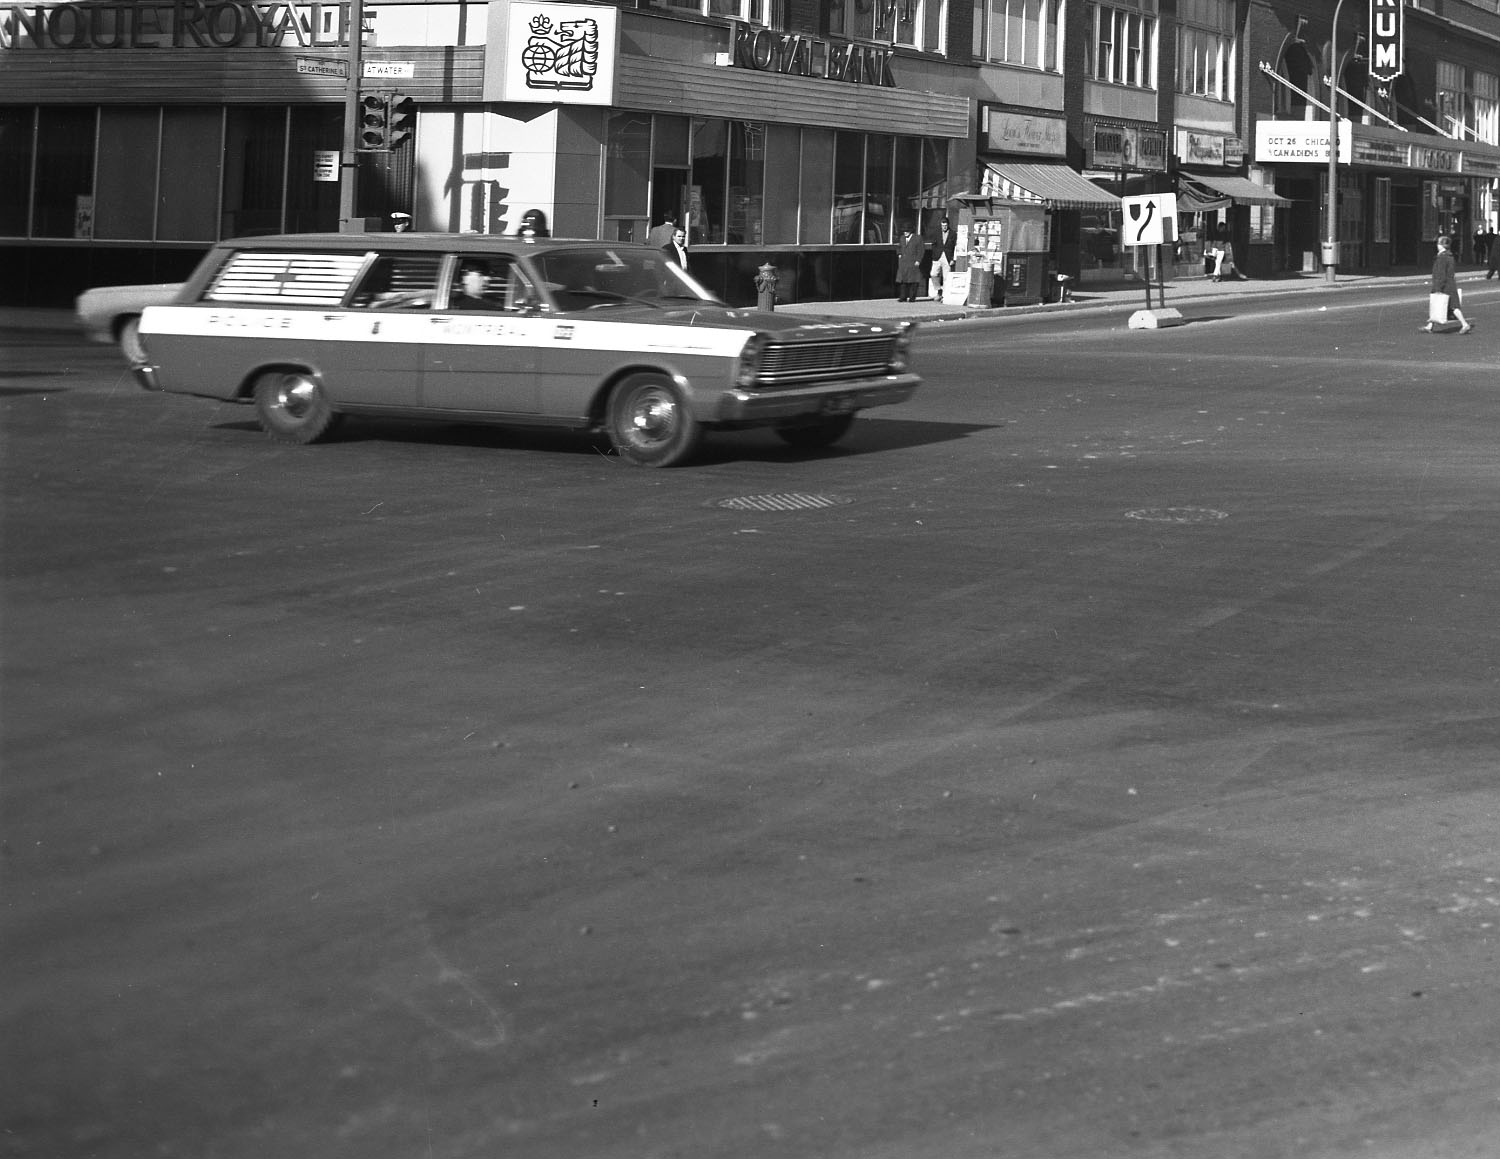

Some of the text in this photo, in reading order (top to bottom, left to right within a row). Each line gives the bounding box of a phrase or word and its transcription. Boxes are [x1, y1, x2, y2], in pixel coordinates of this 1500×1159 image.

[735, 24, 897, 88] ROYAL BANK
[308, 66, 338, 75] CATHERINE
[367, 66, 403, 75] ATWATER
[1268, 137, 1284, 145] OCT
[1287, 137, 1296, 145] 26
